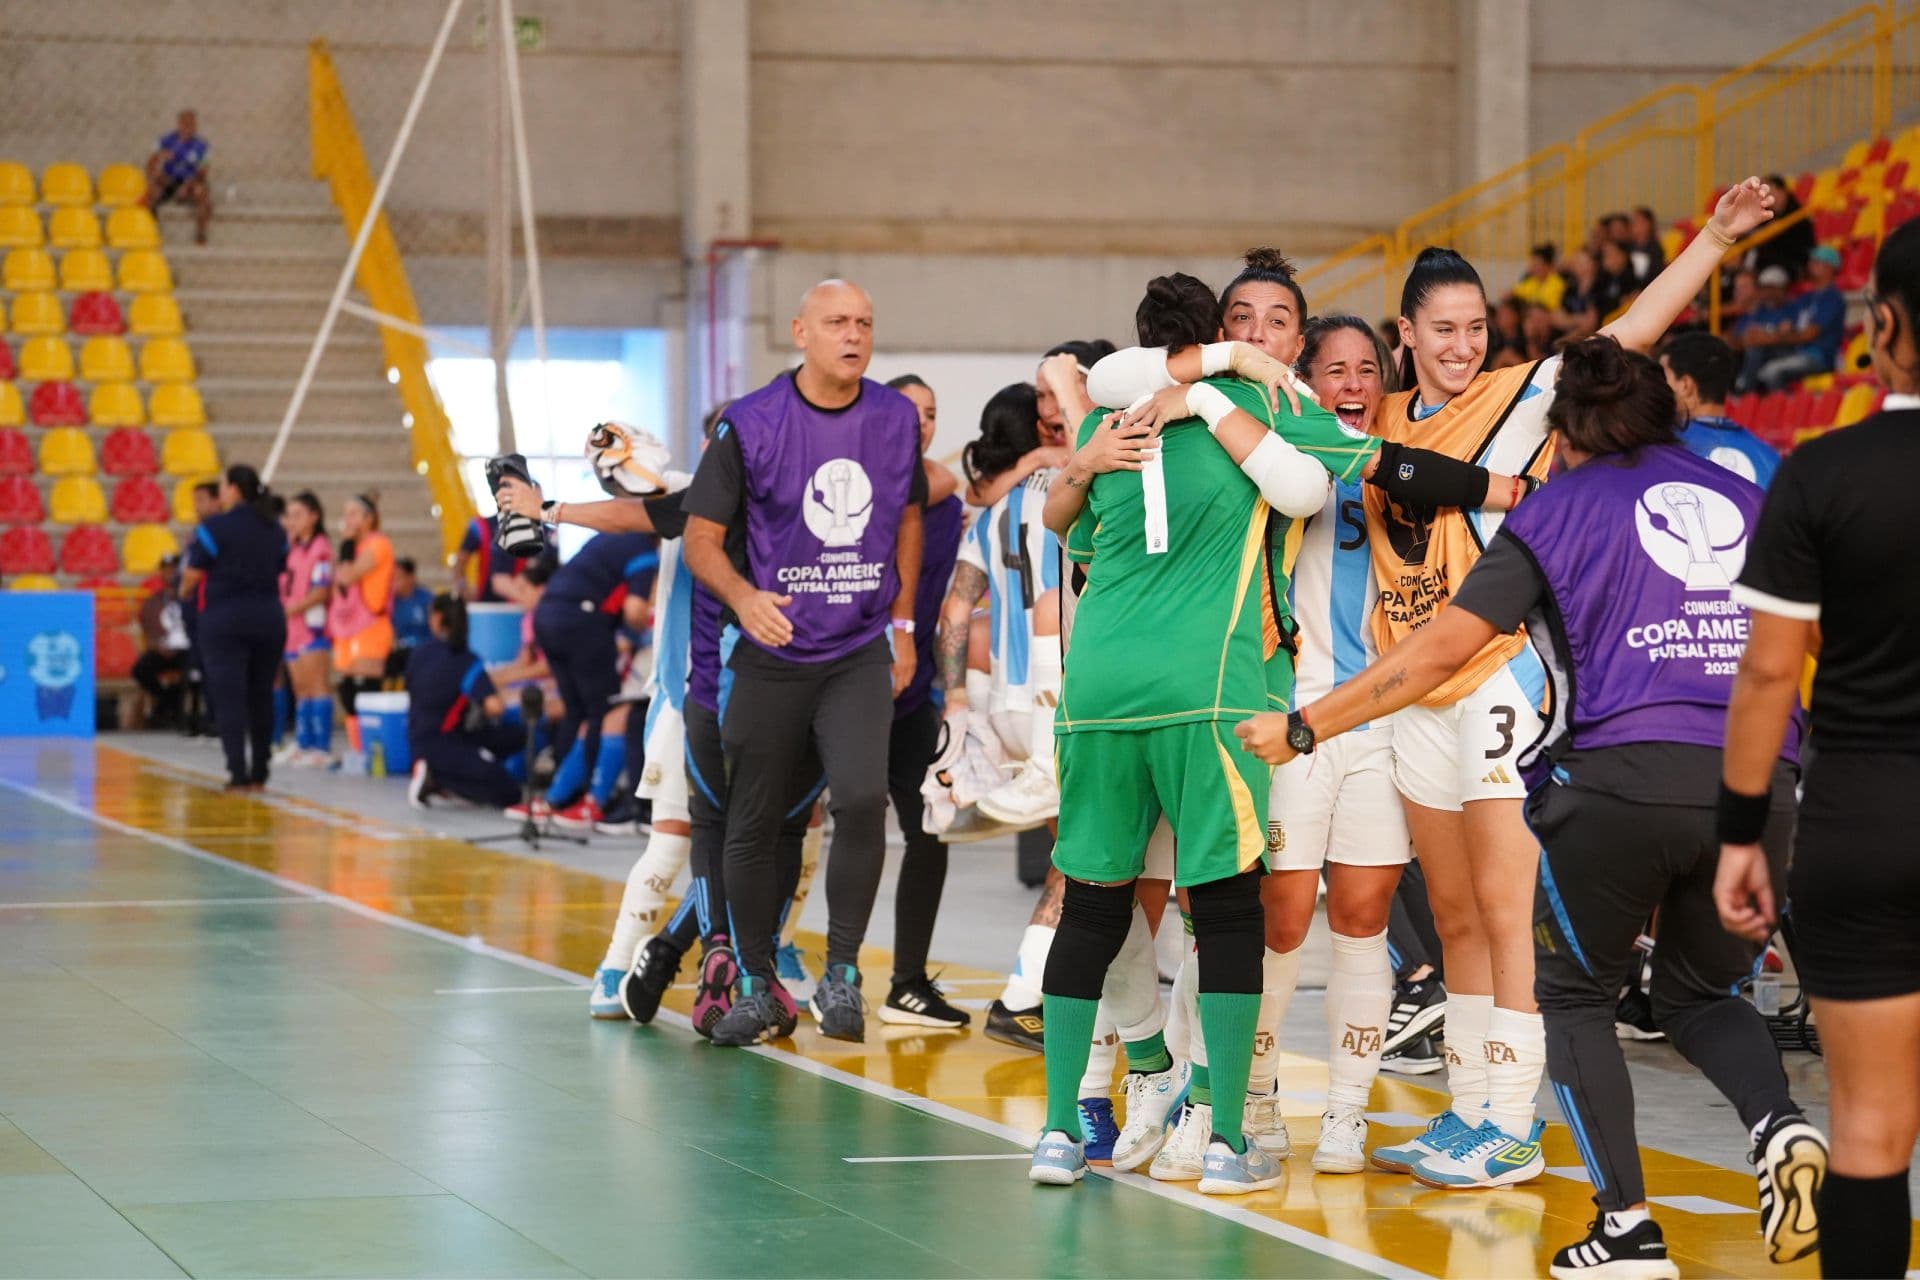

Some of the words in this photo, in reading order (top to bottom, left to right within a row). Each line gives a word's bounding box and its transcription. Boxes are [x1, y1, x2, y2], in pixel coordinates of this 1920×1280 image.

[1340, 500, 1367, 550] 5
[999, 508, 1034, 609] 4
[777, 566, 823, 582] COPA
[825, 563, 885, 580] AMERIC
[787, 582, 831, 593] FUTSAL
[1684, 600, 1741, 615] CONMEBOL
[1626, 619, 1694, 648] COPA
[1697, 618, 1752, 640] AME
[1648, 643, 1708, 663] FUTSAL
[1704, 662, 1738, 675] 2025
[1484, 705, 1516, 759] 3
[1341, 1023, 1381, 1058] AFA
